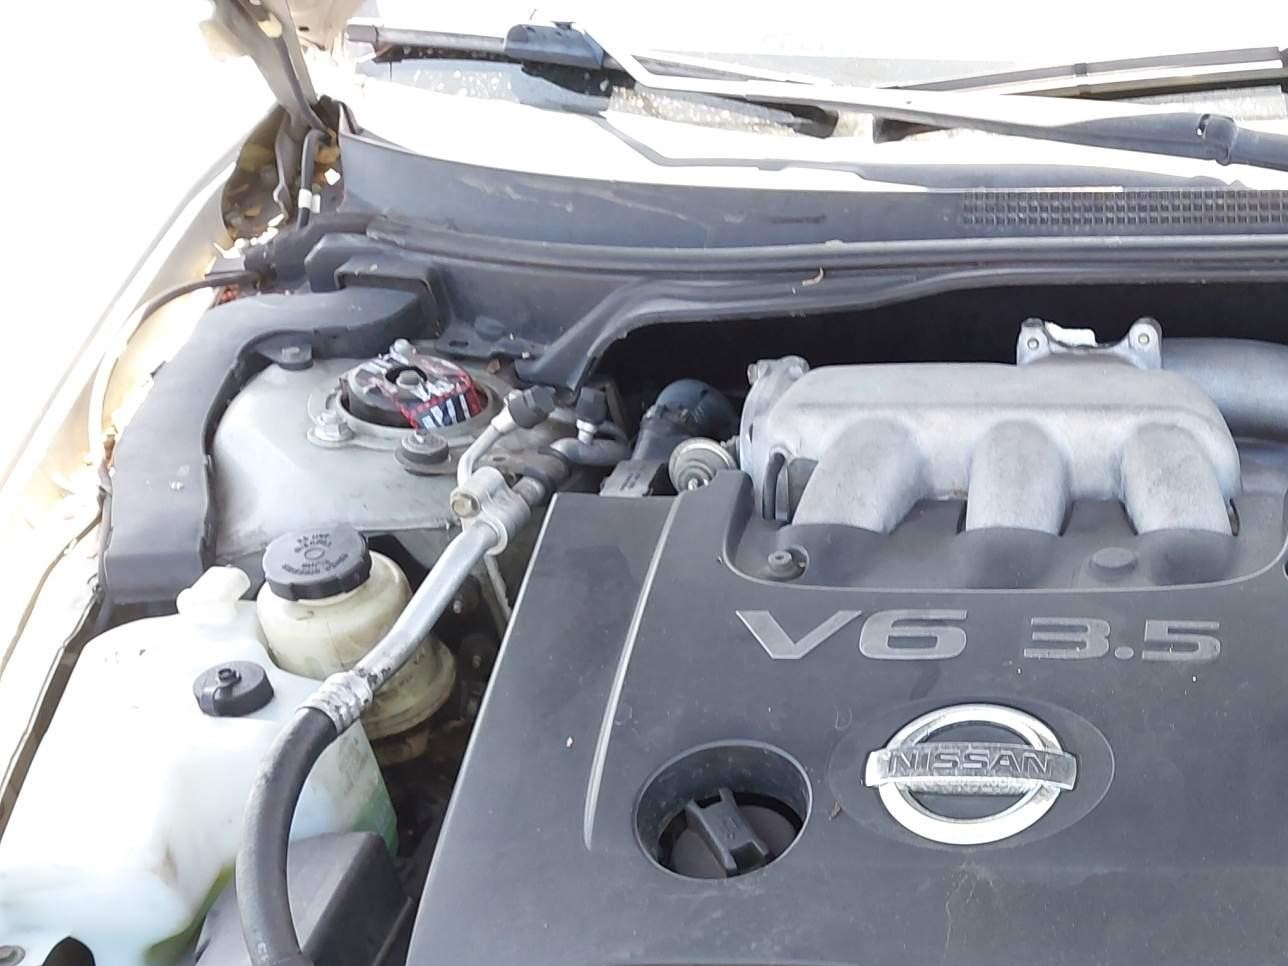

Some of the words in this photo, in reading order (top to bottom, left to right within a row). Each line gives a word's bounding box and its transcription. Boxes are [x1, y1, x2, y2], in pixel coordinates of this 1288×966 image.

[736, 608, 967, 660] V6
[1023, 616, 1221, 661] 3.5
[886, 748, 1055, 777] NISSAN
